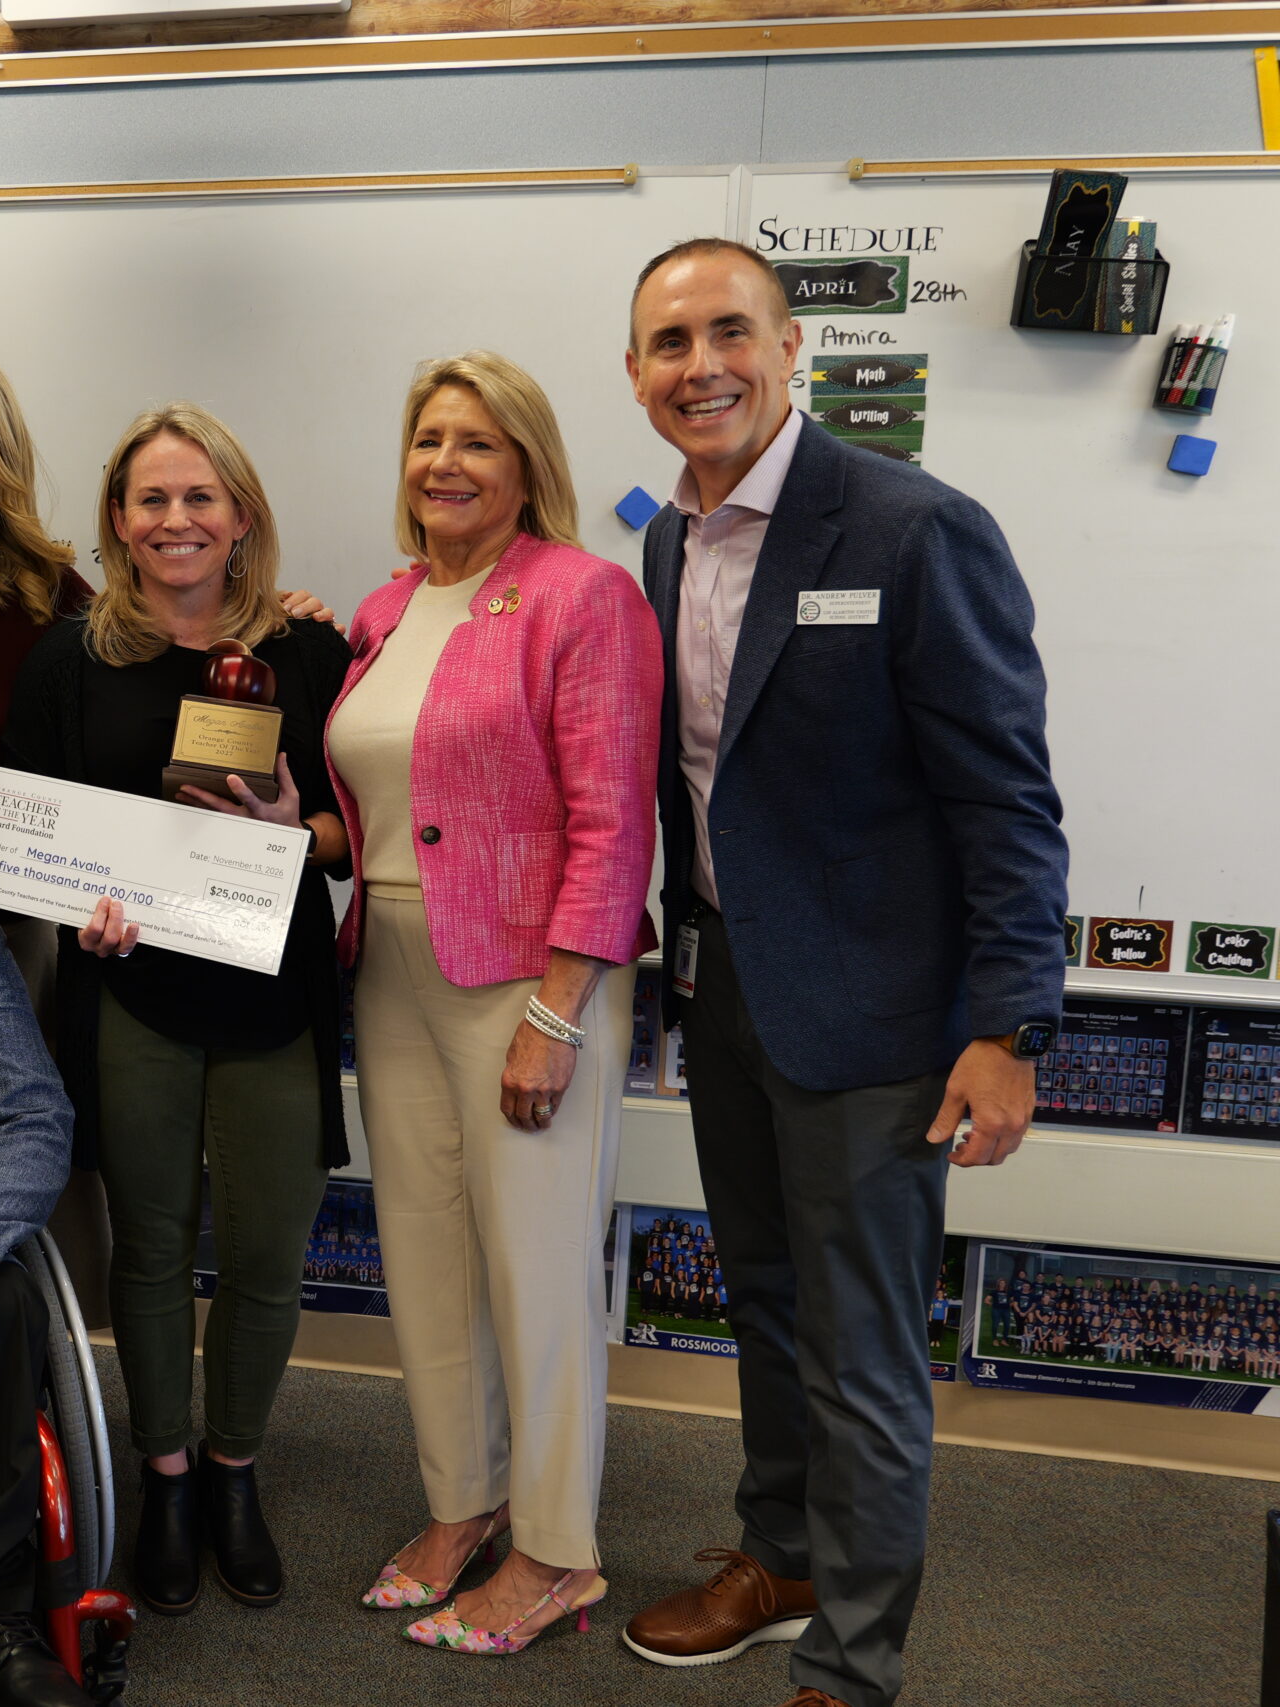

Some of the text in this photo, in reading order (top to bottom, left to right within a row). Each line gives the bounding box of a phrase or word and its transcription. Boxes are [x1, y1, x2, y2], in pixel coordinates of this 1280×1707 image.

[1054, 225, 1086, 277] MAY
[909, 280, 968, 304] 28th
[1119, 282, 1136, 314] Social
[819, 324, 898, 349] Amira
[856, 366, 887, 387] Math
[849, 409, 890, 426] Writing
[815, 592, 847, 600] ANDREW
[849, 591, 878, 600] PULVER
[191, 739, 218, 749] Teacher
[231, 743, 243, 752] The
[198, 733, 254, 747] Orange County
[215, 749, 233, 757] 2027
[2, 808, 20, 820] THE
[20, 812, 57, 831] YEAR
[10, 822, 55, 840] Foundation
[265, 842, 288, 855] 2027
[9, 845, 19, 855] of
[26, 846, 68, 866] Megan
[68, 857, 112, 877] Avalos
[189, 850, 211, 864] Date:
[213, 854, 253, 871] November
[264, 865, 285, 878] 2026
[23, 865, 82, 889] thousand
[82, 881, 108, 896] and
[108, 885, 155, 907] 00/100
[17, 890, 40, 903] Teachers
[39, 896, 46, 904] of
[46, 898, 55, 906] the
[55, 900, 67, 909] Year
[67, 903, 84, 914] Award
[209, 884, 274, 909] $25,000.00
[153, 924, 162, 933] by
[183, 931, 195, 940] and
[1110, 926, 1152, 943] Godric's
[1215, 933, 1251, 949] Leaky
[1110, 947, 1148, 962] Hollow
[1207, 951, 1254, 968] Cauldron
[1088, 1012, 1139, 1022] Elementary School
[670, 1337, 738, 1355] ROSSMOOR
